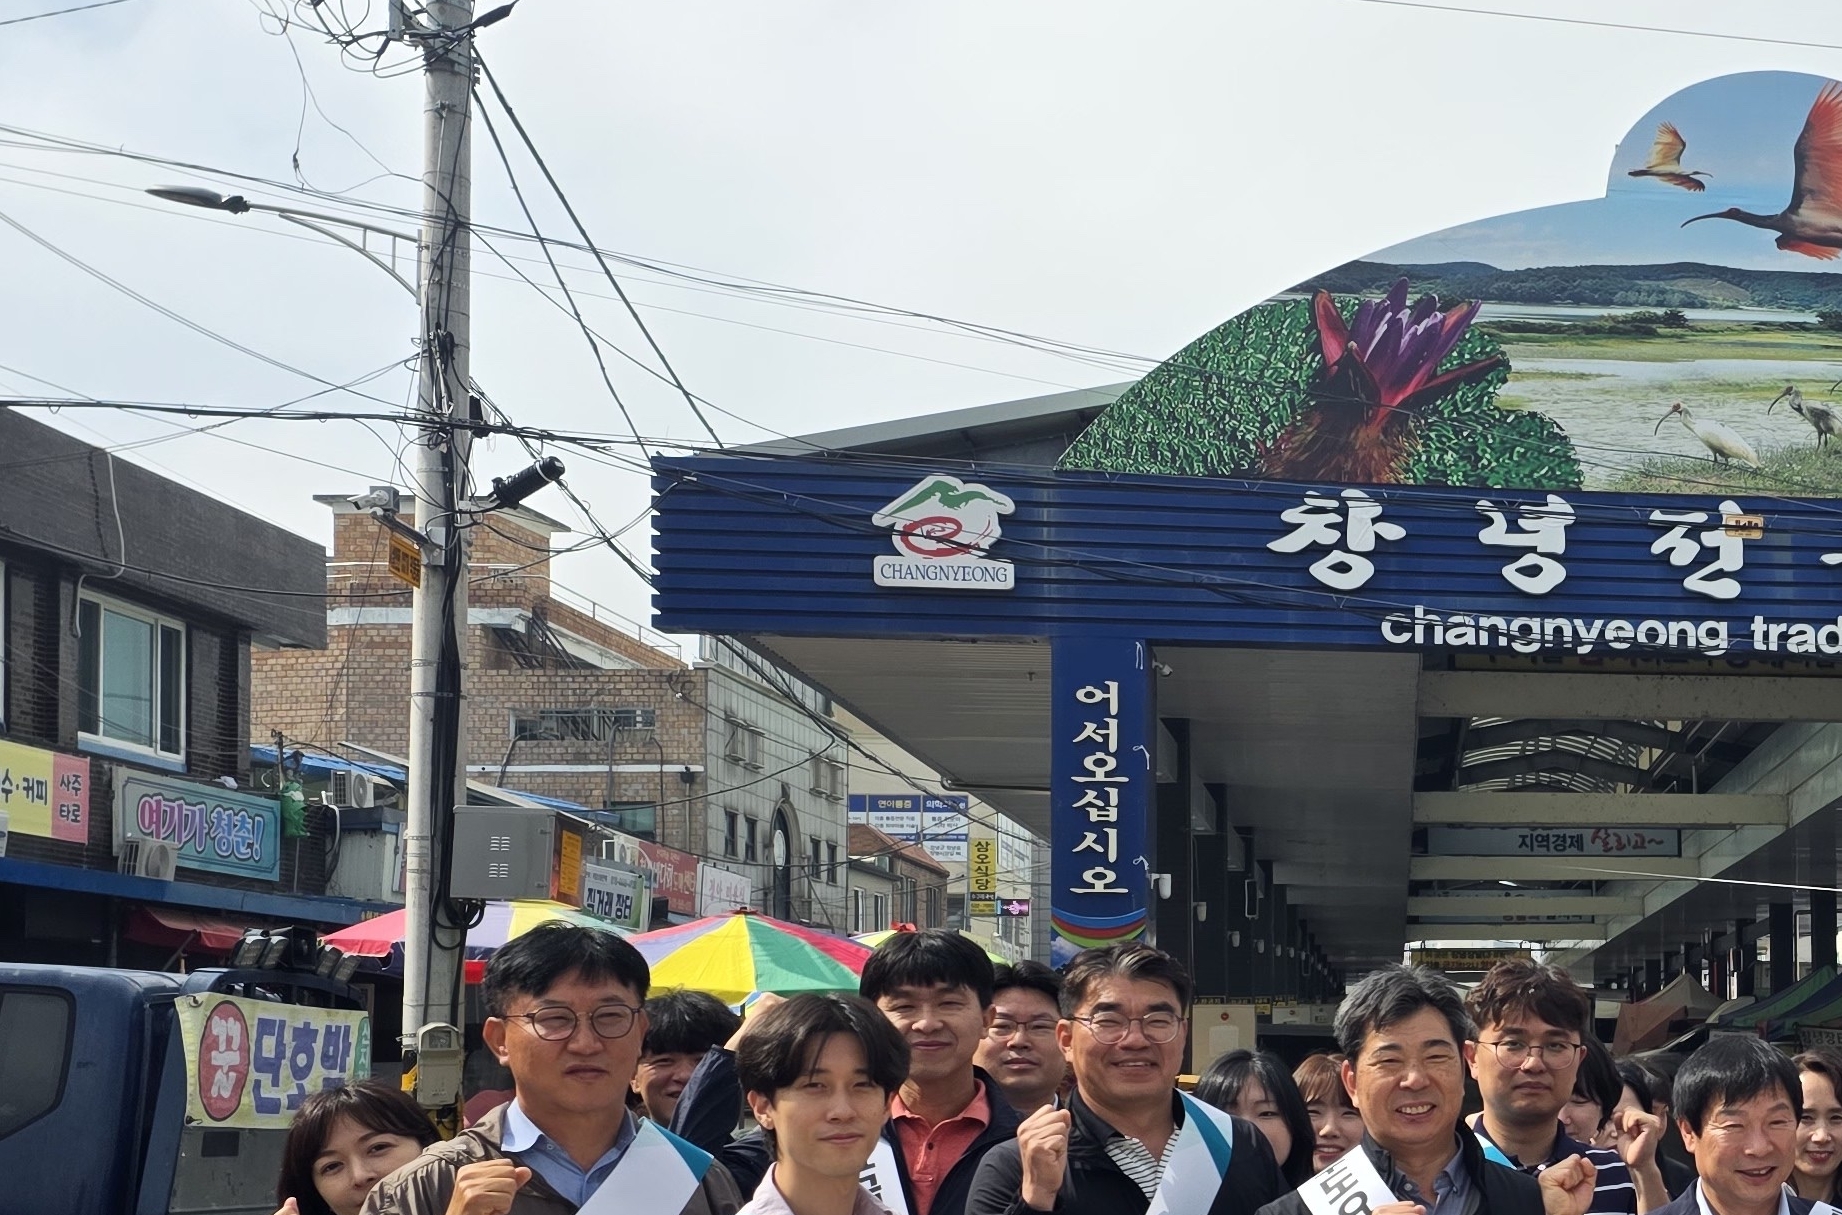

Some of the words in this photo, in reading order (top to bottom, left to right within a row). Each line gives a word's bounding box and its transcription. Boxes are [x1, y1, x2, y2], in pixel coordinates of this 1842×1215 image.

[880, 563, 1008, 583] CHANGNYEONG
[1381, 605, 1729, 655] changnyeong
[59, 773, 82, 797] 사주
[1070, 681, 1129, 894] 어서오십시오
[59, 803, 81, 824] 타로
[138, 794, 209, 852] 여기가
[211, 806, 264, 862] 청춘!
[974, 841, 992, 891] 삼오식당
[1518, 833, 1584, 852] 지역경제
[211, 1014, 242, 1099] 꿀
